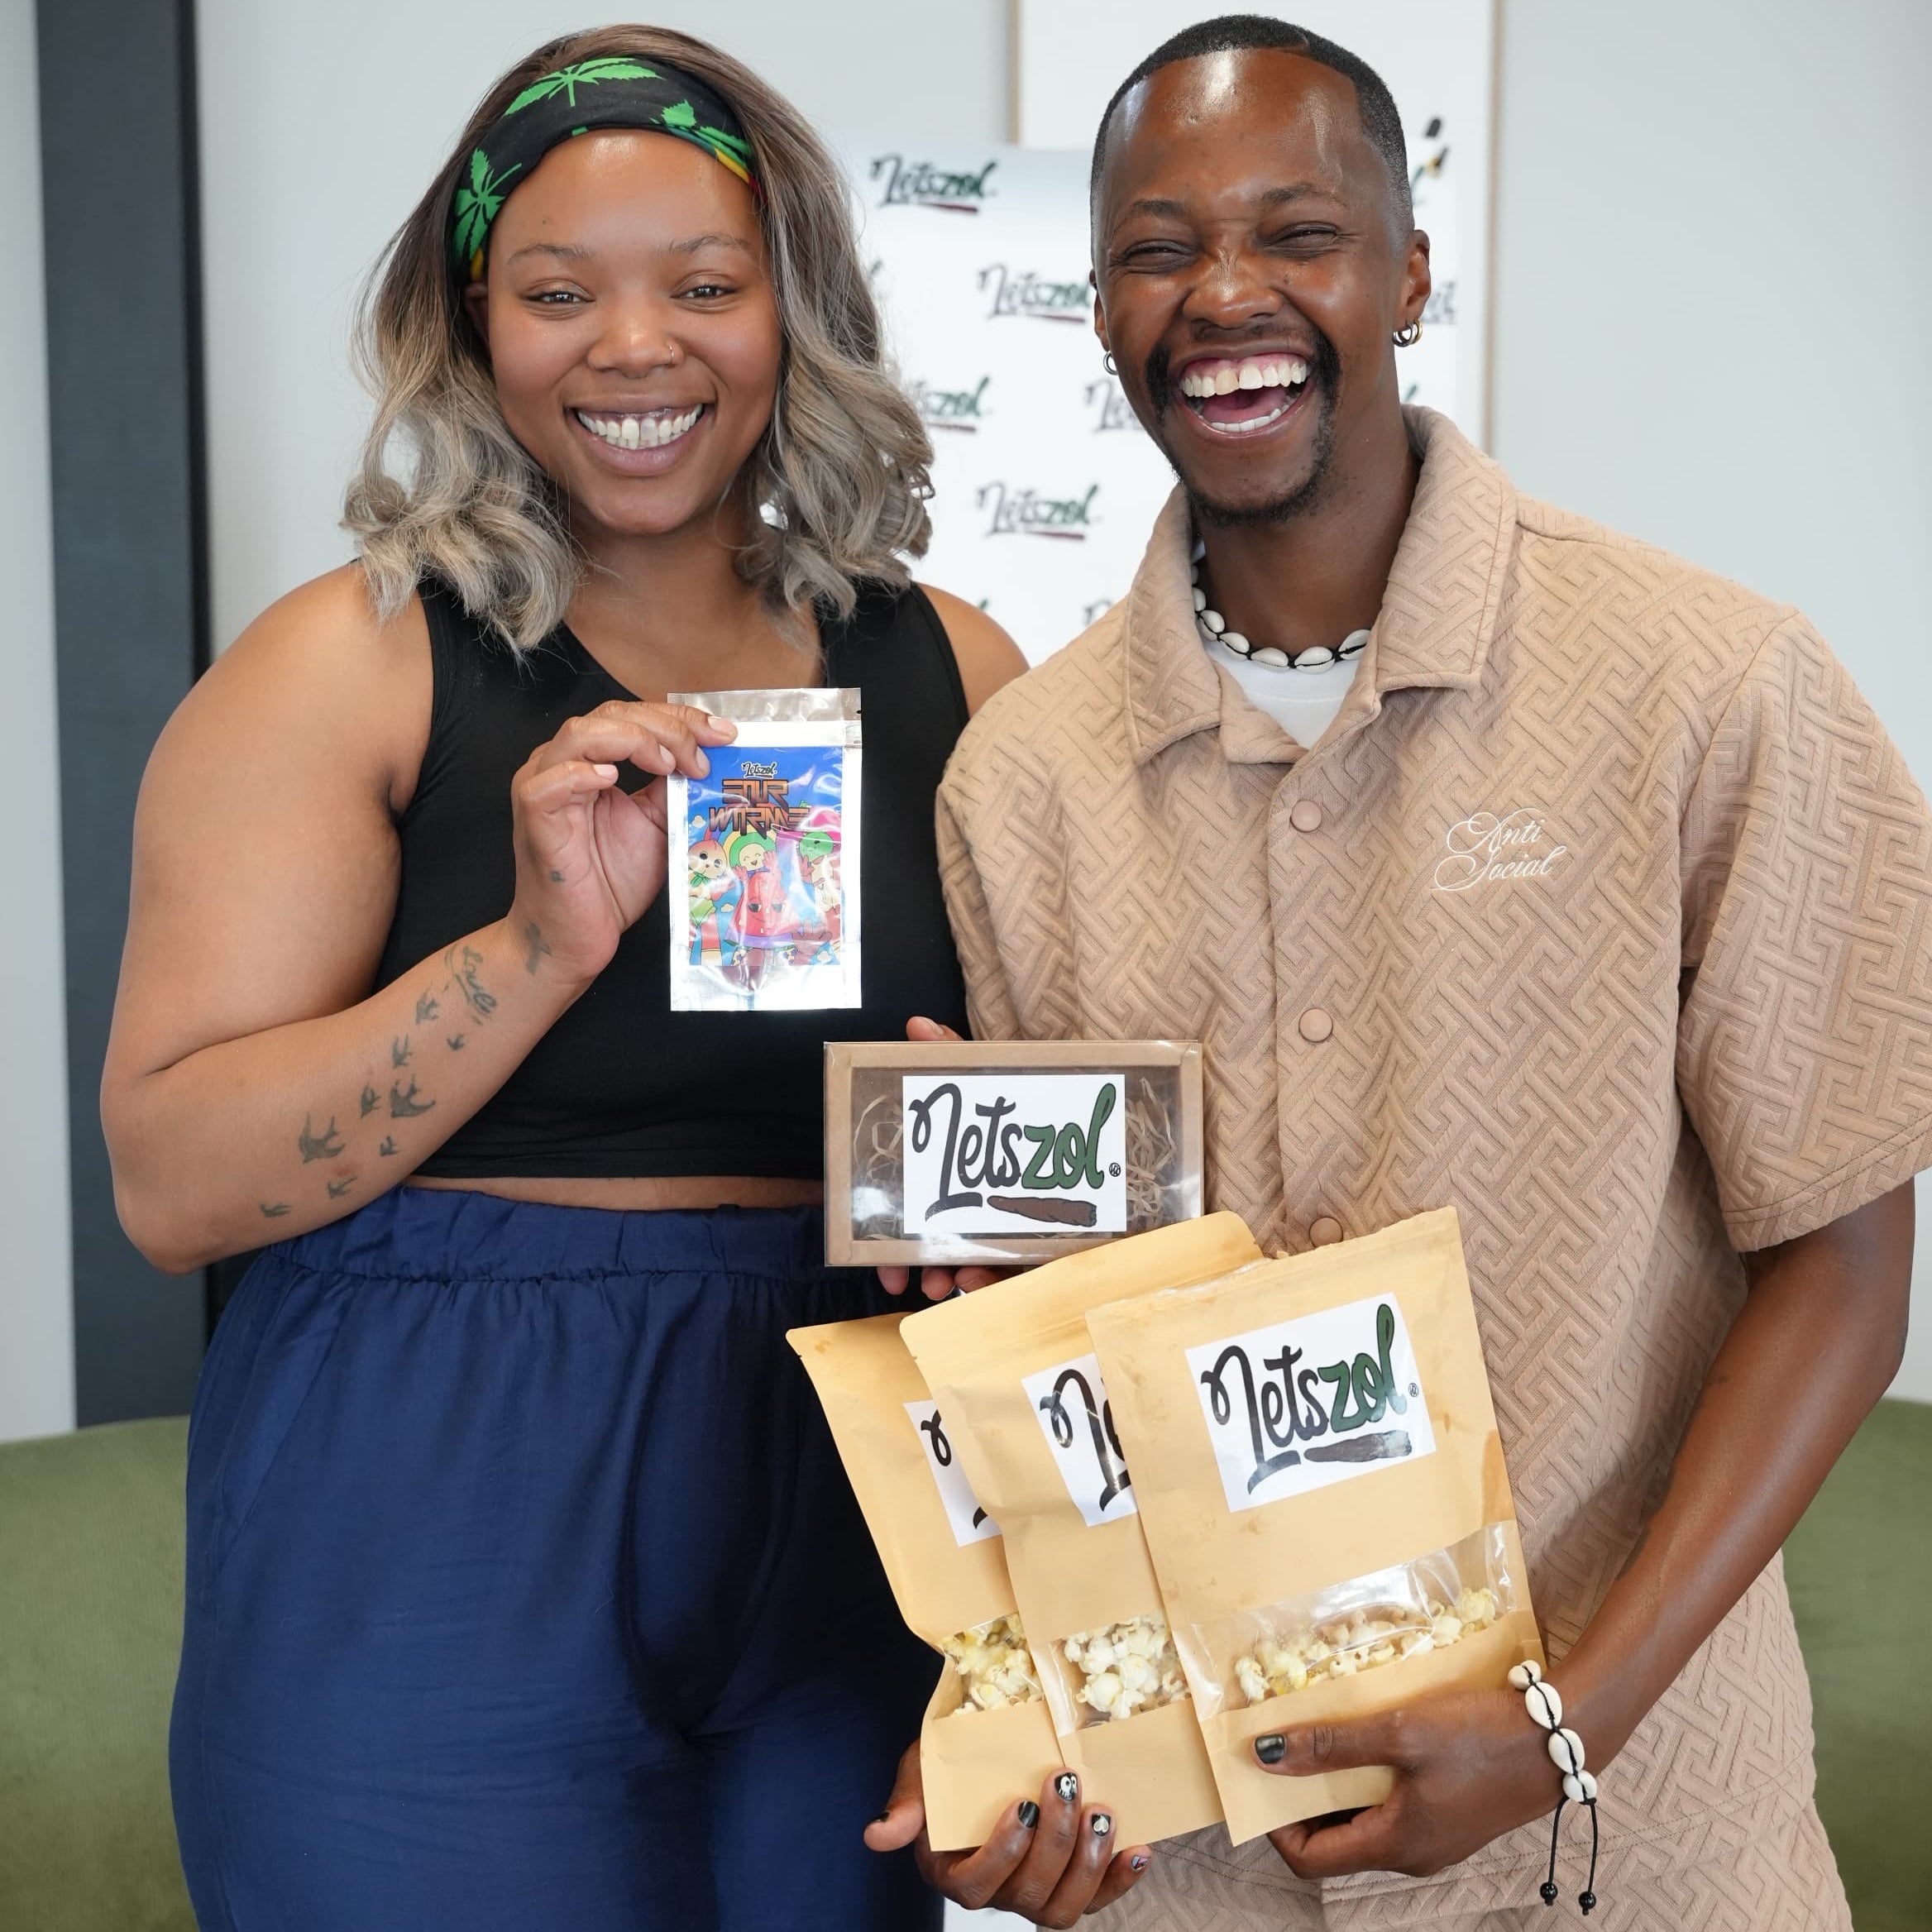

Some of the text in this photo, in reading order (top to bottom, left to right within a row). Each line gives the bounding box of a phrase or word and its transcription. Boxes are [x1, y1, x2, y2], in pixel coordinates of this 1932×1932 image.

[722, 779, 789, 812] SOUR
[1447, 807, 1547, 854] Anti
[1428, 844, 1567, 892] Social
[908, 1083, 1117, 1222] Letszol
[1200, 1303, 1408, 1495] Letszol
